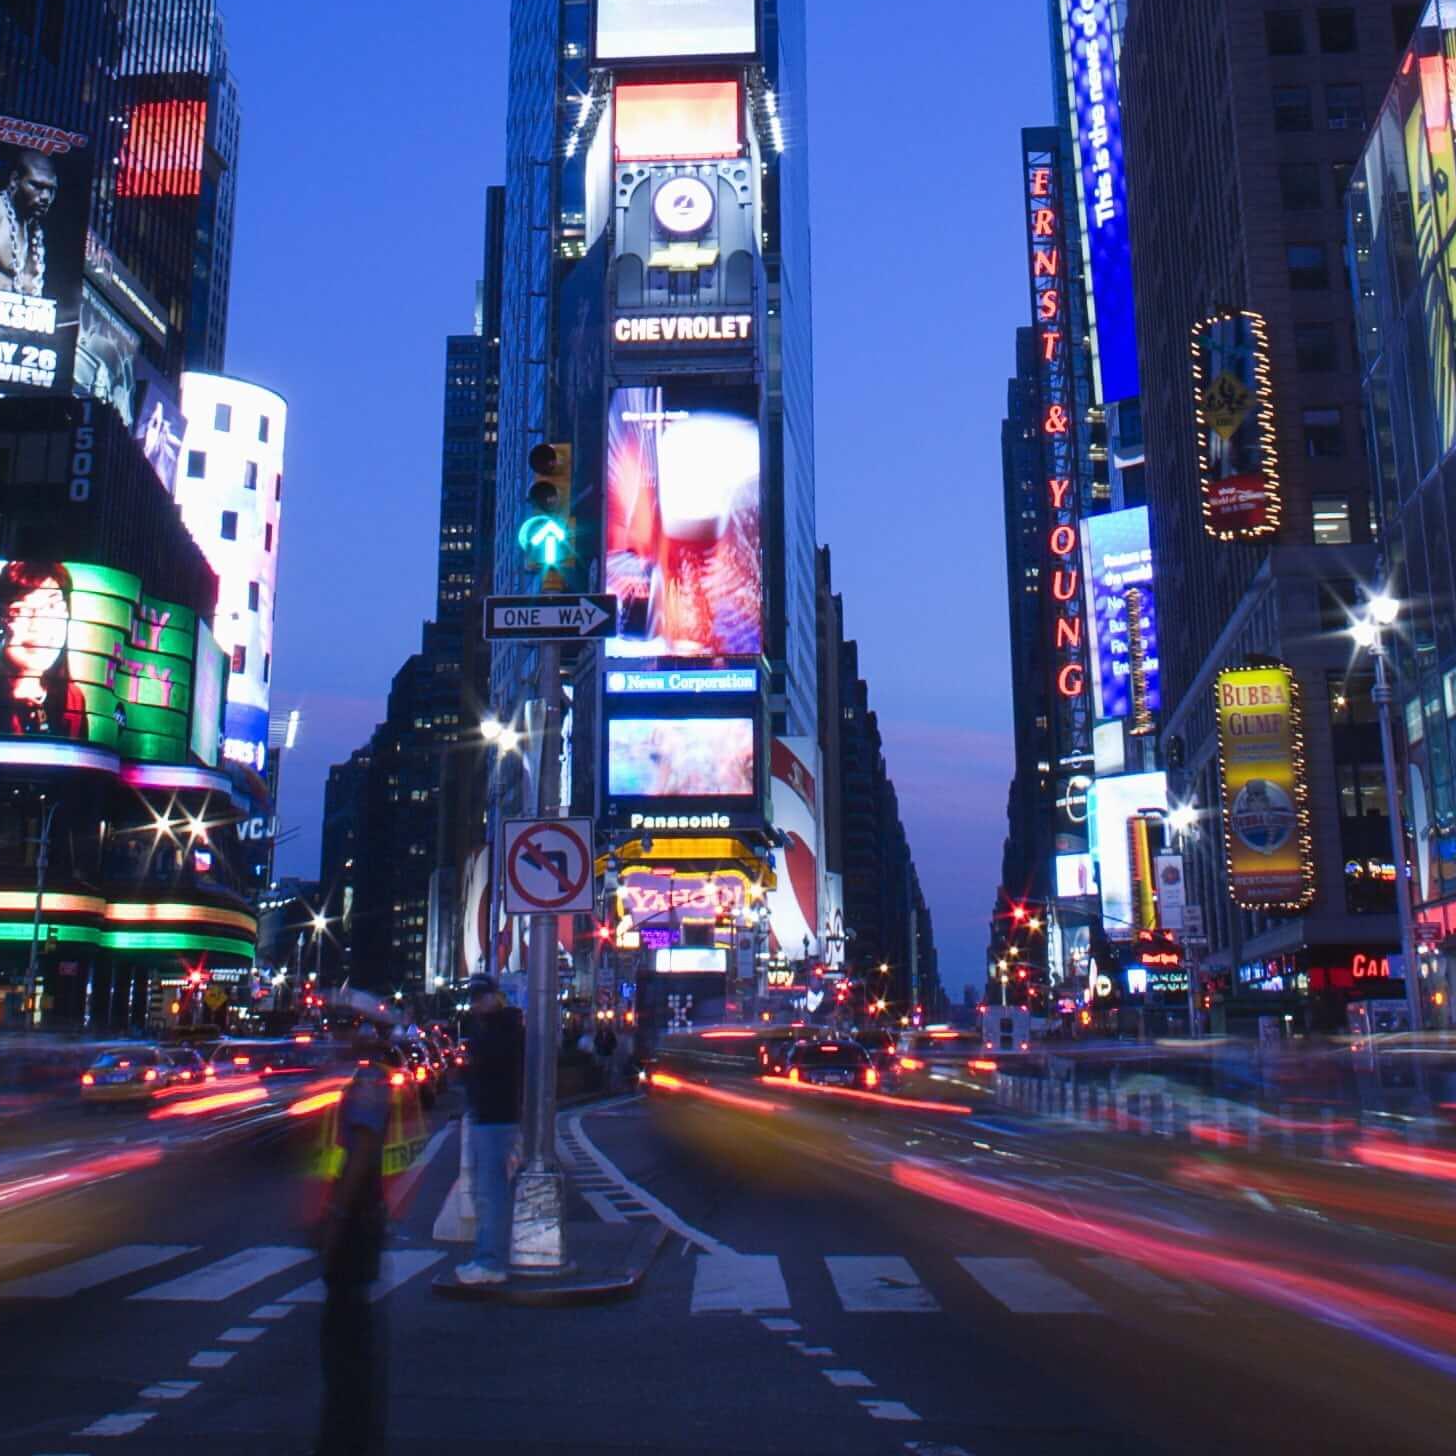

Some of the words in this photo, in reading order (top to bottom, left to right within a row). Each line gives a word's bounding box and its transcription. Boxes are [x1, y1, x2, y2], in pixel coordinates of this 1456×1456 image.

[1077, 10, 1097, 37] of
[1086, 39, 1104, 103] news
[1088, 104, 1108, 149] the
[1092, 147, 1110, 173] is
[1094, 172, 1115, 228] This
[1031, 169, 1060, 361] ERNST
[615, 315, 751, 341] CHEVROLET
[22, 347, 56, 371] 26
[1045, 405, 1068, 433] &
[69, 401, 94, 502] 1500
[1049, 479, 1083, 697] YOUNG
[504, 609, 540, 626] ONE
[558, 608, 596, 626] WAY
[627, 676, 664, 689] News
[669, 674, 753, 693] Corporation
[1222, 683, 1287, 707] BUBBA
[1228, 712, 1283, 737] GUMP
[631, 812, 730, 829] Panasonic
[628, 886, 742, 913] YAHOO!
